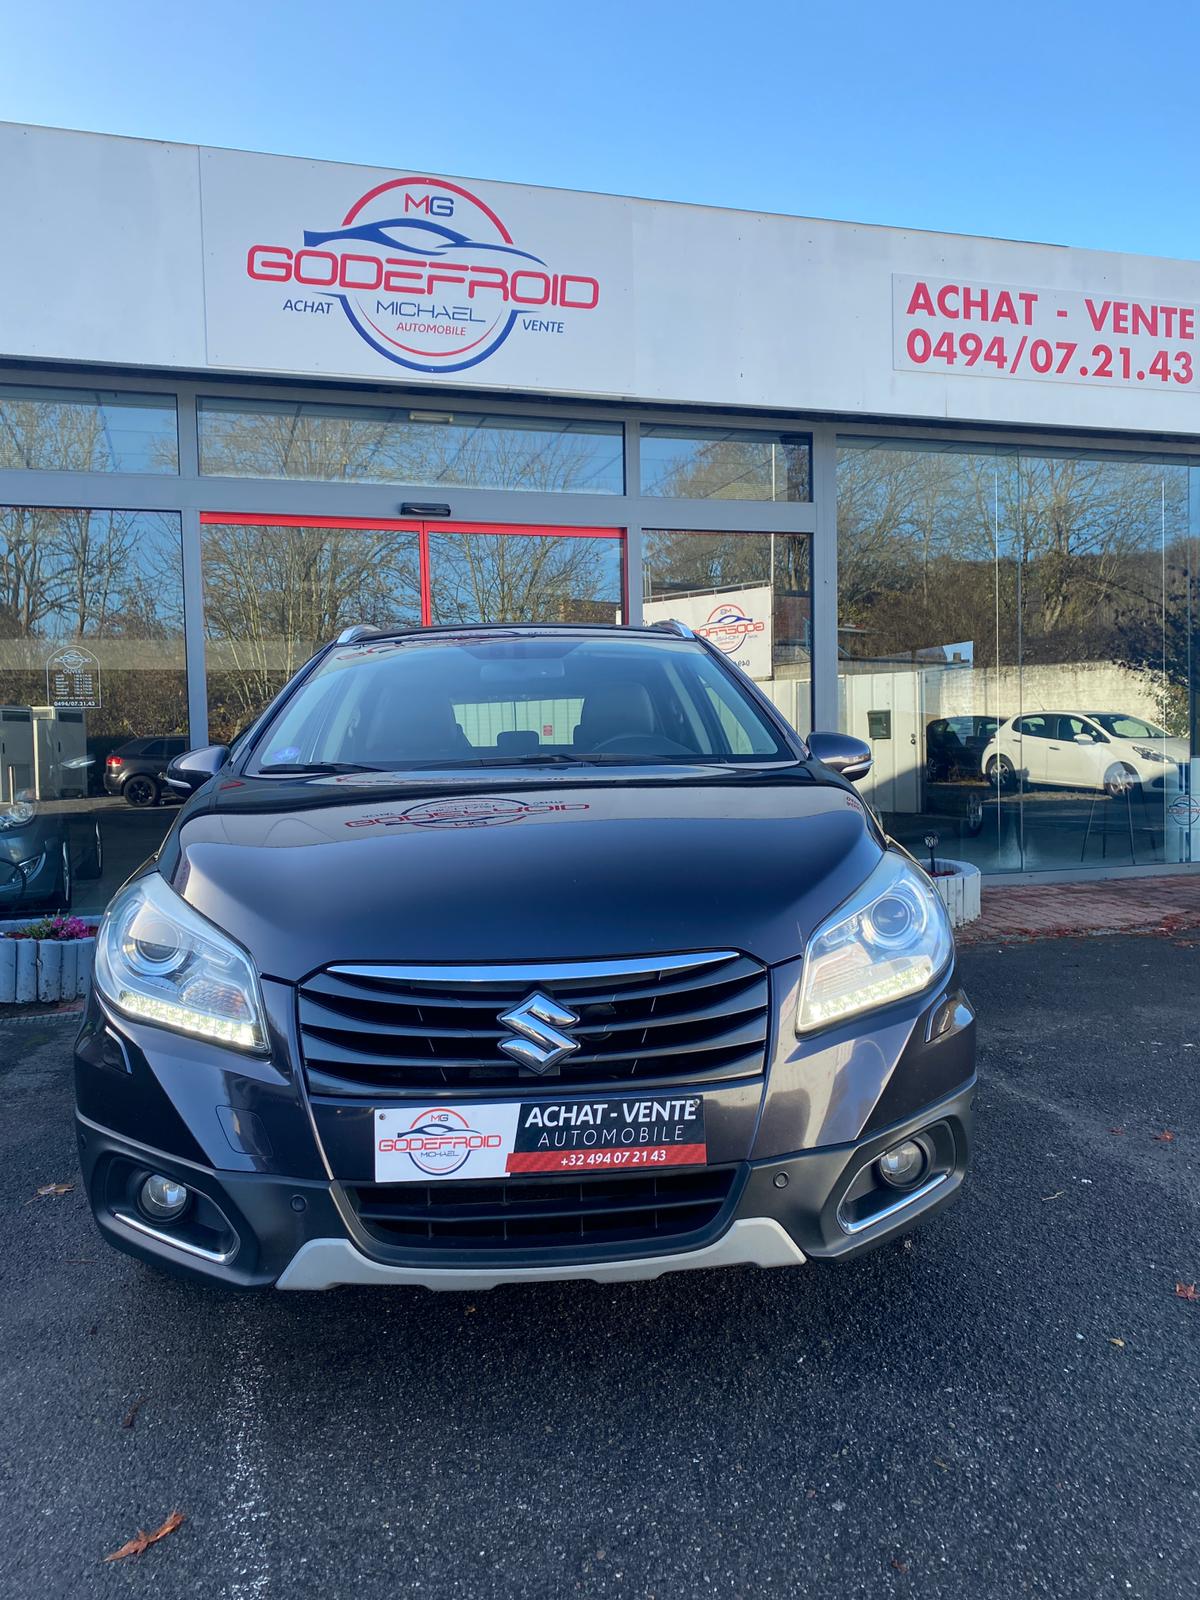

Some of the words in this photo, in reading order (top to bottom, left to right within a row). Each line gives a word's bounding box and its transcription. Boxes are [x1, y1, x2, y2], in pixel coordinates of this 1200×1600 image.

[404, 192, 455, 218] MG
[246, 244, 600, 310] GODEFROID
[282, 298, 334, 315] ACHAT
[376, 299, 487, 323] MICHAEL
[906, 281, 1039, 327] ACHAT
[1056, 309, 1068, 318] -
[1084, 298, 1195, 340] VENTE
[395, 321, 467, 337] AUTOMOBILE
[521, 318, 565, 334] VENTE
[906, 327, 1194, 385] 0494/07.21.43
[430, 1113, 449, 1122] MG
[378, 1134, 503, 1152] GODEFROID
[537, 1124, 685, 1148] AUTOMOBILE
[420, 1150, 460, 1158] MICHAEL
[560, 1153, 584, 1167] +32
[586, 1152, 611, 1165] 494
[613, 1150, 628, 1164] 07
[631, 1150, 648, 1163] 21
[649, 1149, 667, 1162] 43
